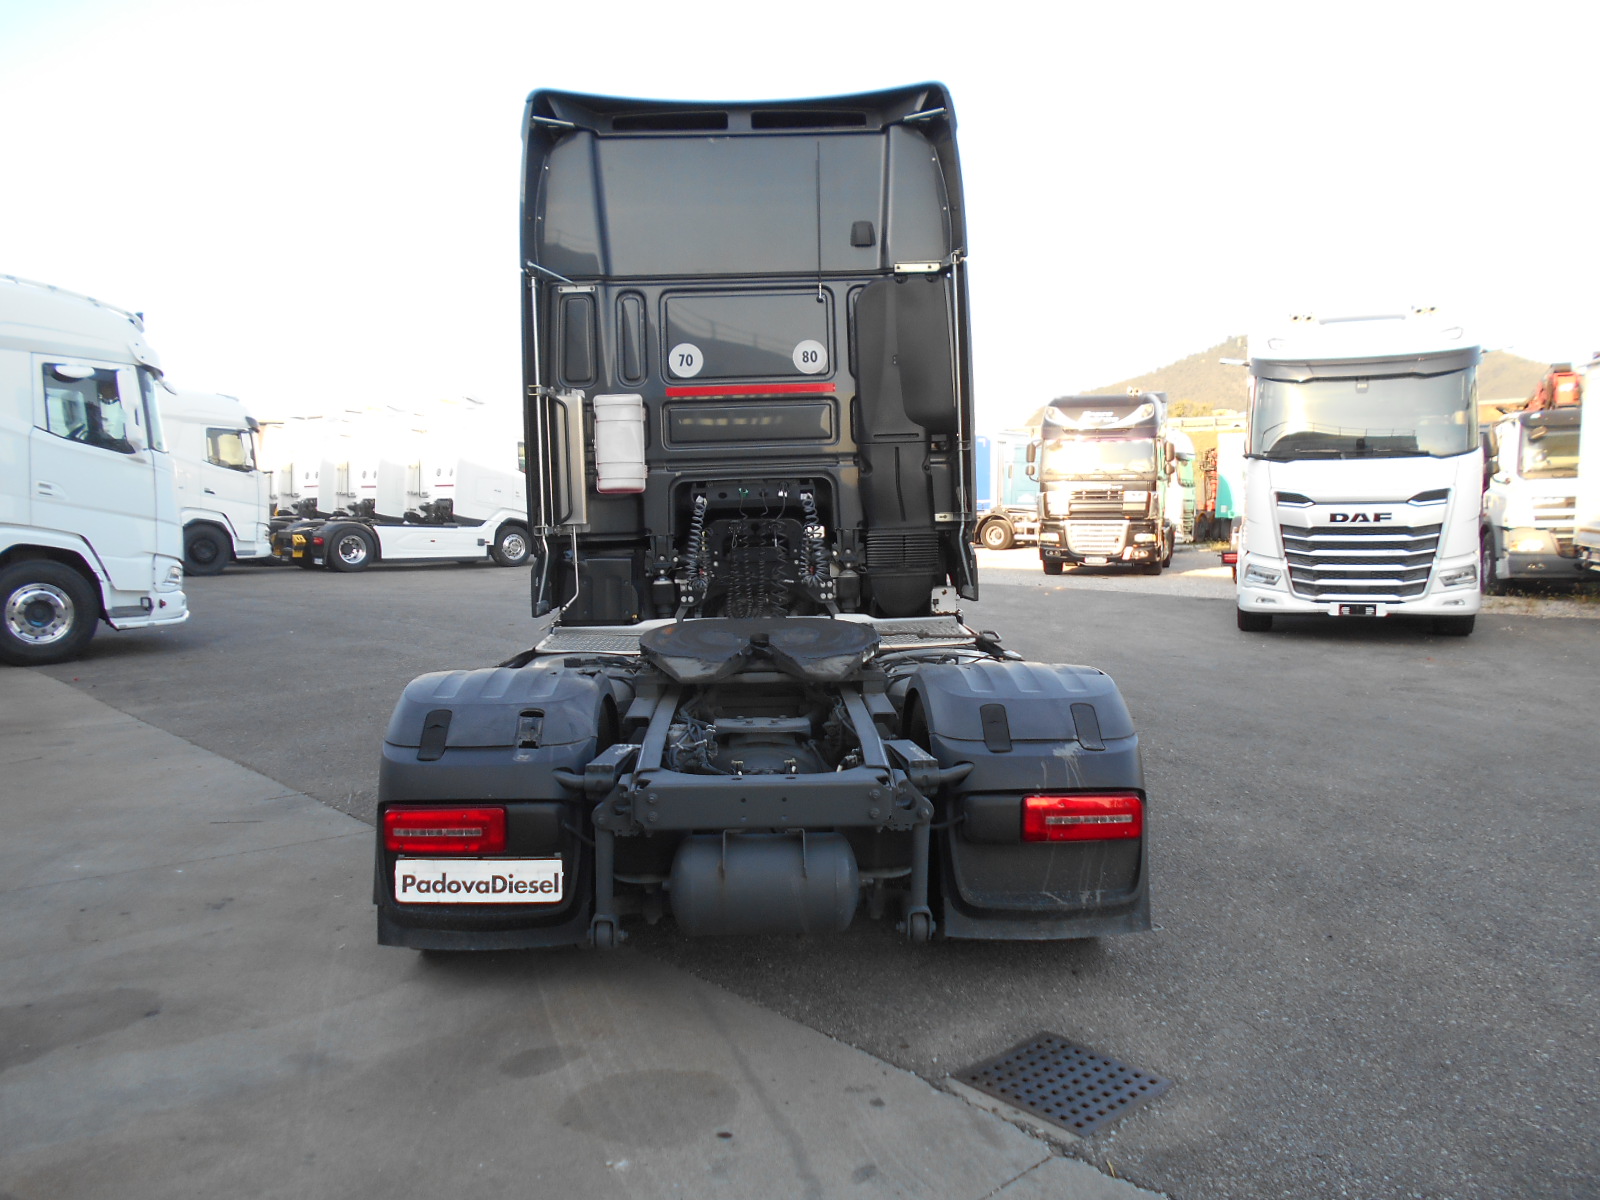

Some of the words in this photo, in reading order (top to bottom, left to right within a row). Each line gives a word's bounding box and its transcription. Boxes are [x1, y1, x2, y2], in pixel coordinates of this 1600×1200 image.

[678, 354, 694, 367] 70
[802, 350, 818, 363] 80
[1329, 512, 1392, 522] DAF
[402, 872, 559, 894] PadovaDiesel
